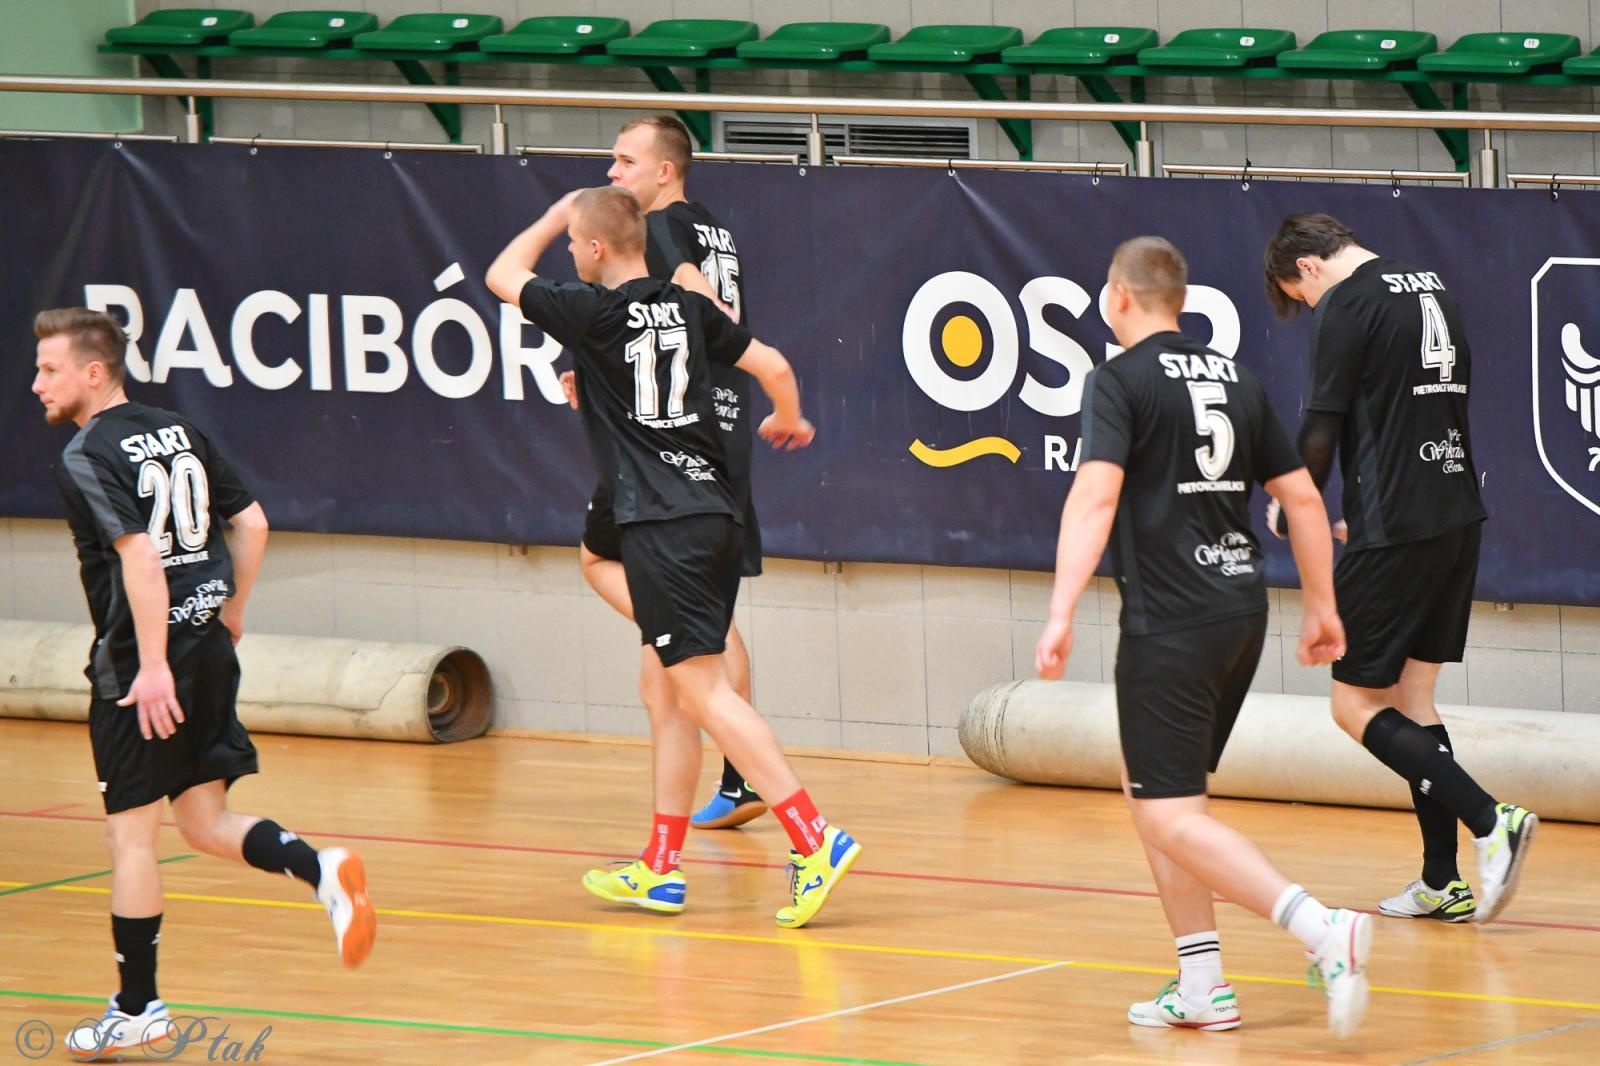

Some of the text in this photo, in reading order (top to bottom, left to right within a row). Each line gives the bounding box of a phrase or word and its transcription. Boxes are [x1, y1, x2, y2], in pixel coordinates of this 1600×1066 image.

[1381, 271, 1446, 293] START
[627, 301, 686, 328] START
[1420, 293, 1455, 382] 4
[624, 328, 690, 418] 17
[1159, 353, 1238, 382] START
[120, 425, 192, 463] START
[1186, 380, 1235, 481] 5
[137, 452, 210, 557] 20
